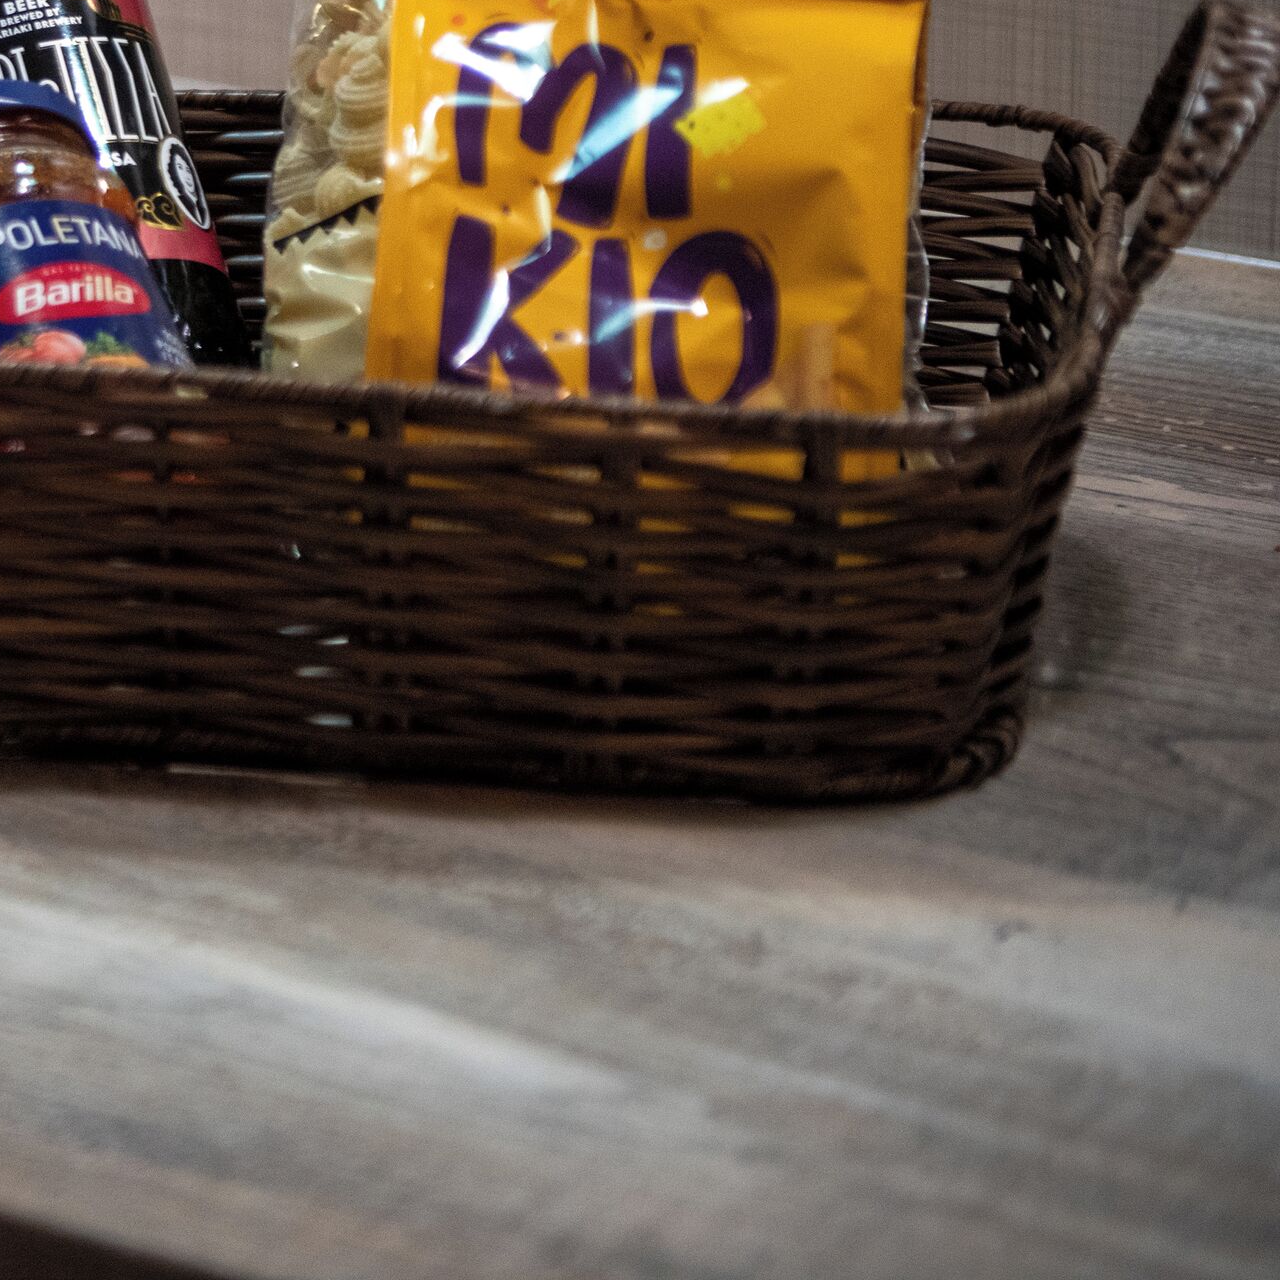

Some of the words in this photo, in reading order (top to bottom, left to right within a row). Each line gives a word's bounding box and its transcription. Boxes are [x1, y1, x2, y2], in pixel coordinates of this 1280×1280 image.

[0, 10, 44, 27] BREWED
[45, 7, 60, 17] BY
[33, 16, 83, 30] BREWERY
[14, 274, 135, 317] Barilla
